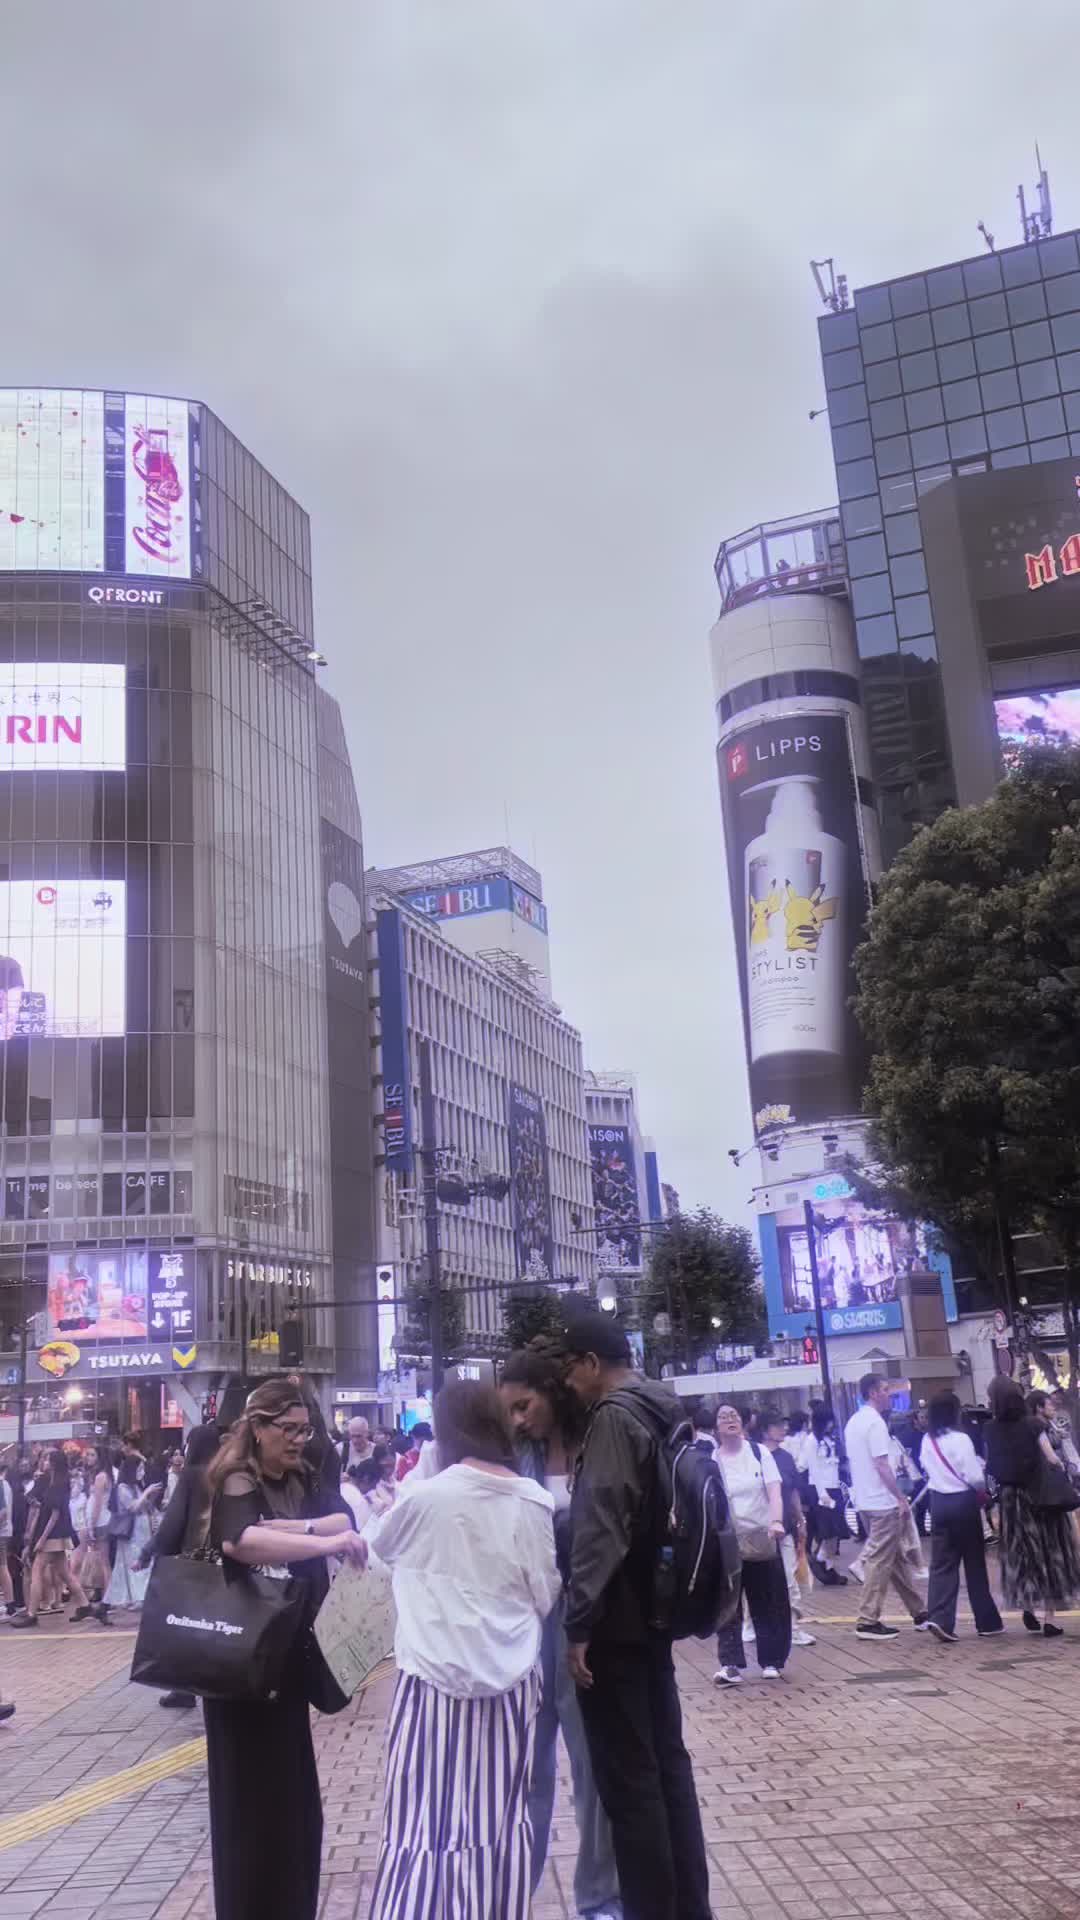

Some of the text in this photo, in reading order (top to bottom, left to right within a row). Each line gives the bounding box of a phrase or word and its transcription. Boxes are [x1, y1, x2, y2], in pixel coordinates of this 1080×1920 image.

[88, 587, 163, 604] QFRONT
[756, 736, 821, 760] LIPPS
[411, 885, 491, 914] SEIBU
[752, 957, 818, 980] STYLIST
[385, 1083, 404, 1156] SEIBU
[126, 1175, 165, 1188] CAFE
[227, 1260, 311, 1288] STARBUCKS
[171, 1310, 192, 1327] 1F
[88, 1353, 162, 1369] TSUTAYA
[215, 1621, 244, 1636] Tiger
